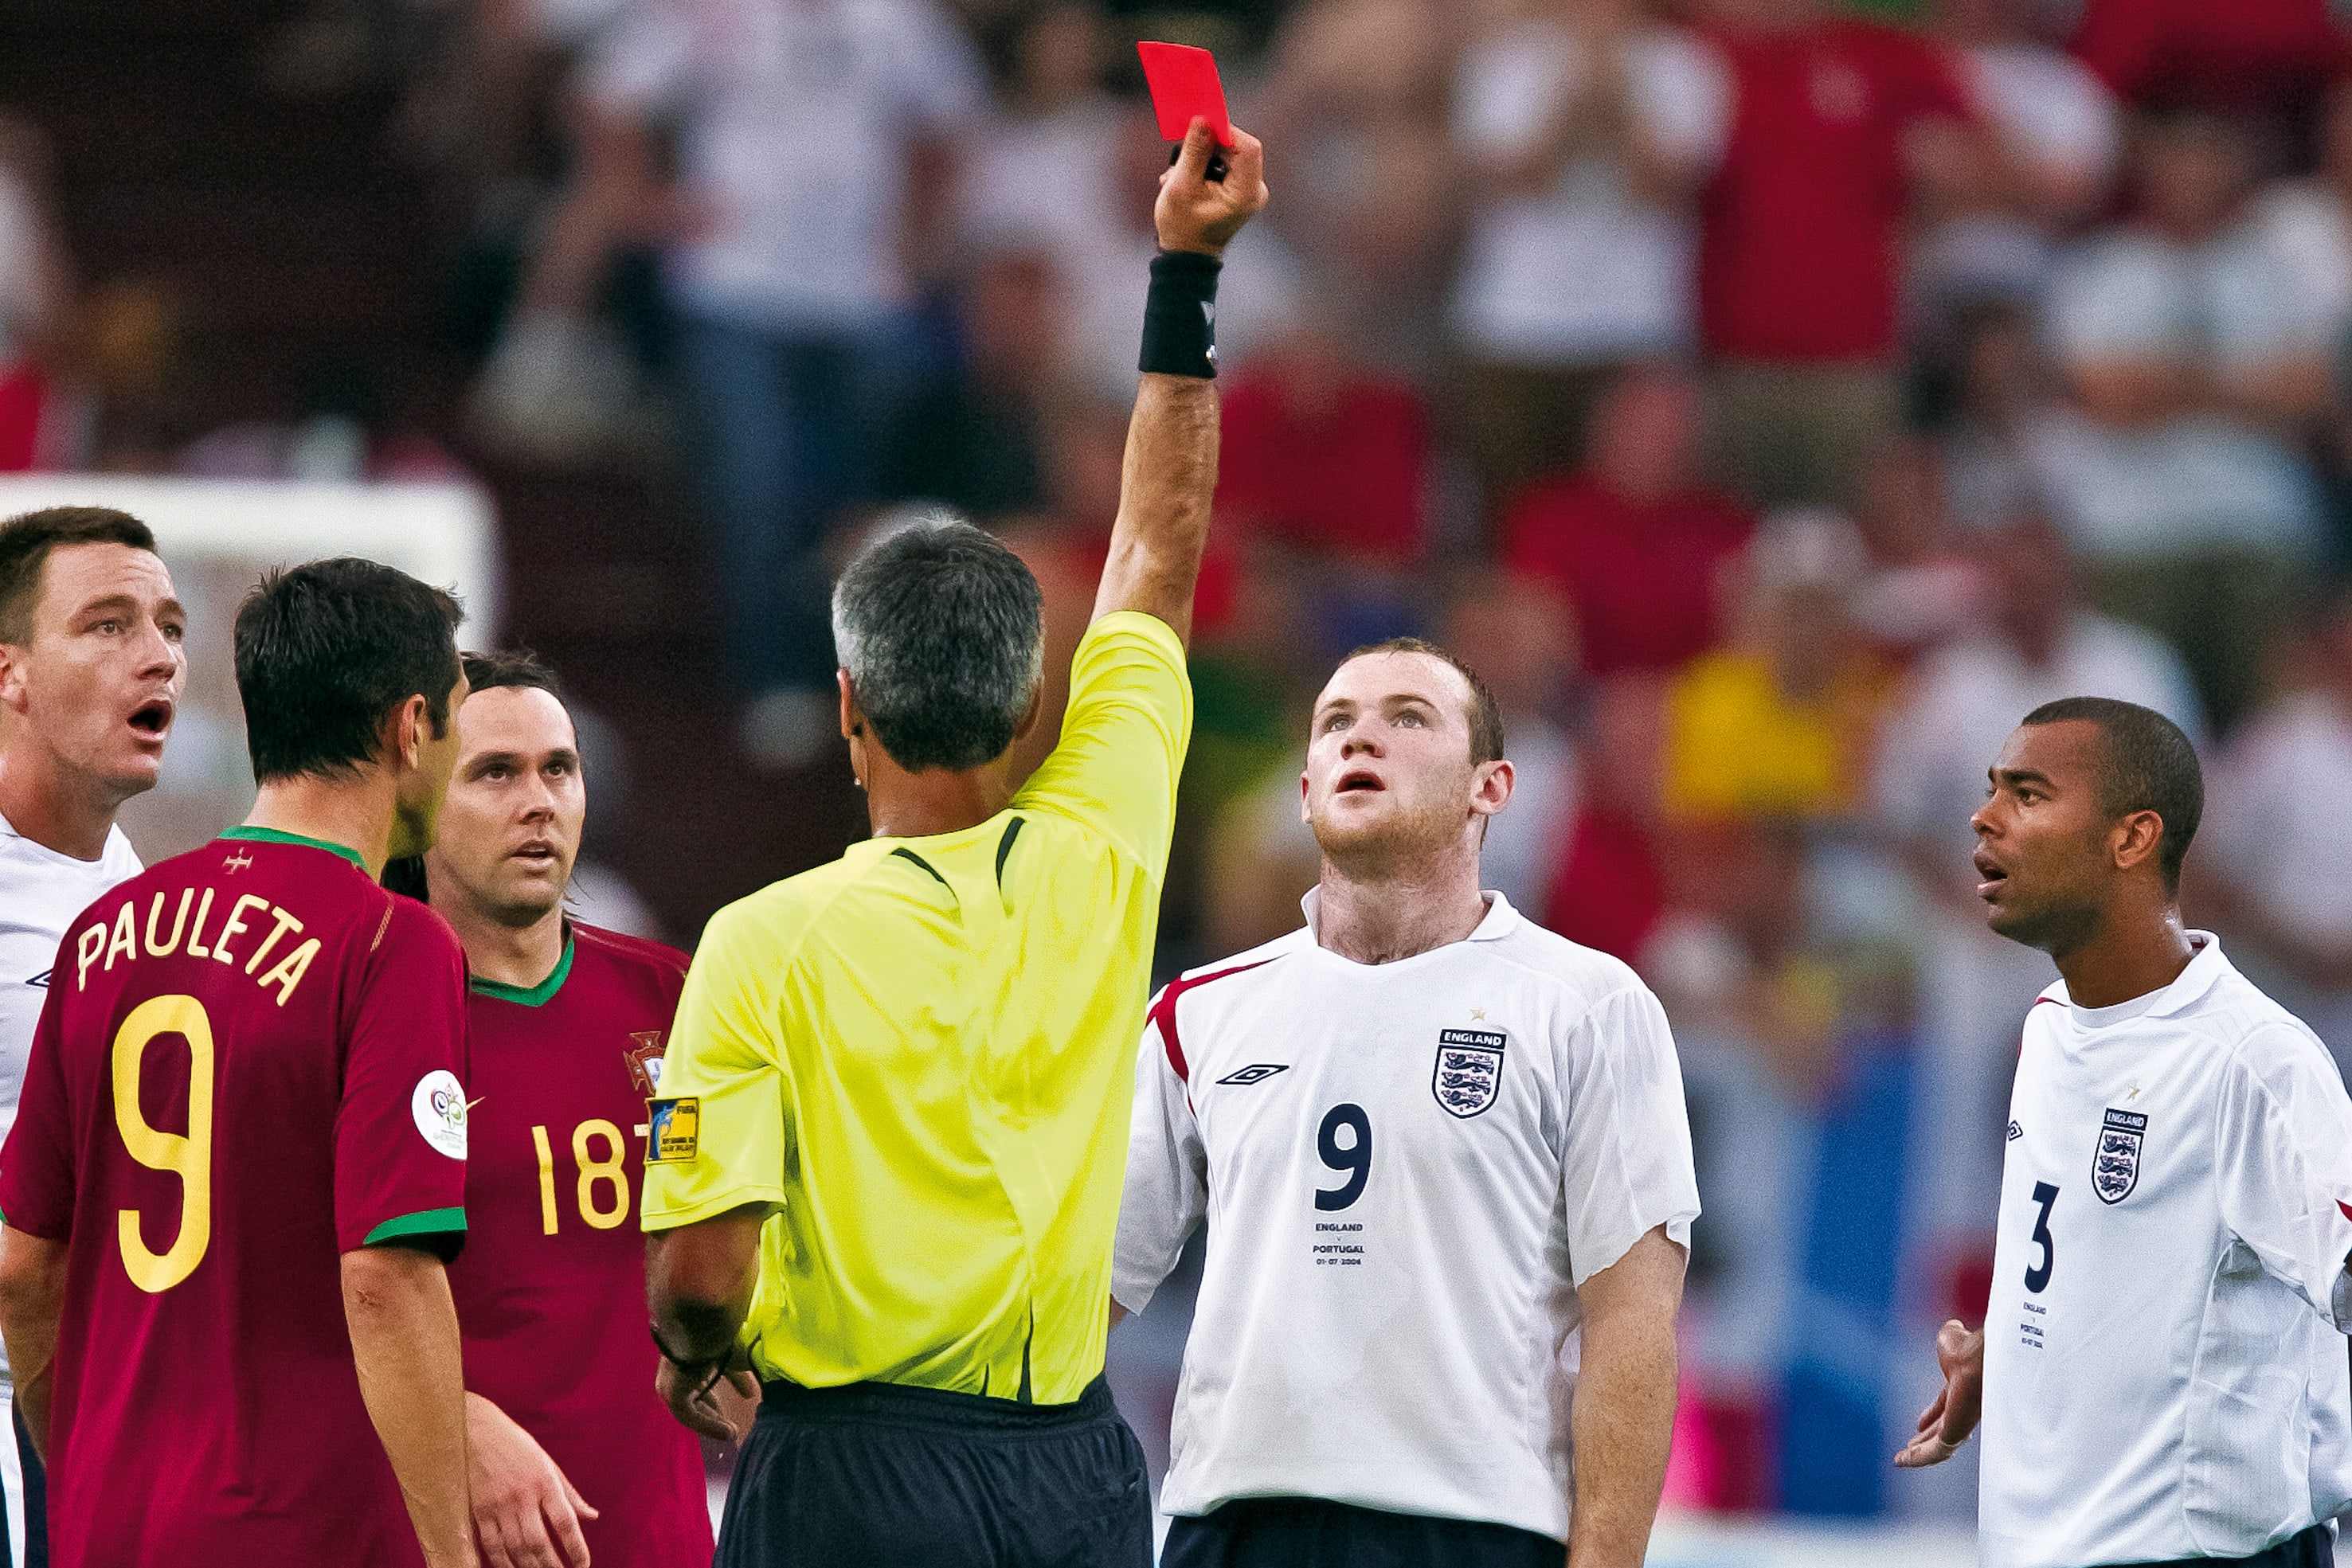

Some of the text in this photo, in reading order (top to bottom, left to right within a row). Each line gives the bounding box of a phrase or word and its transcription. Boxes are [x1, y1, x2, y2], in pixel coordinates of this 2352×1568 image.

[77, 887, 322, 1007] PAULETA
[1444, 1031, 1502, 1046] ENGLAND
[112, 994, 215, 1294] 9
[1314, 1104, 1372, 1211] 9
[2107, 1112, 2145, 1127] ENGLAND
[531, 1118, 631, 1236] 18
[1316, 1223, 1363, 1232] ENGLAND
[1313, 1245, 1365, 1253] PORTUGAL
[2024, 1180, 2060, 1293] 3
